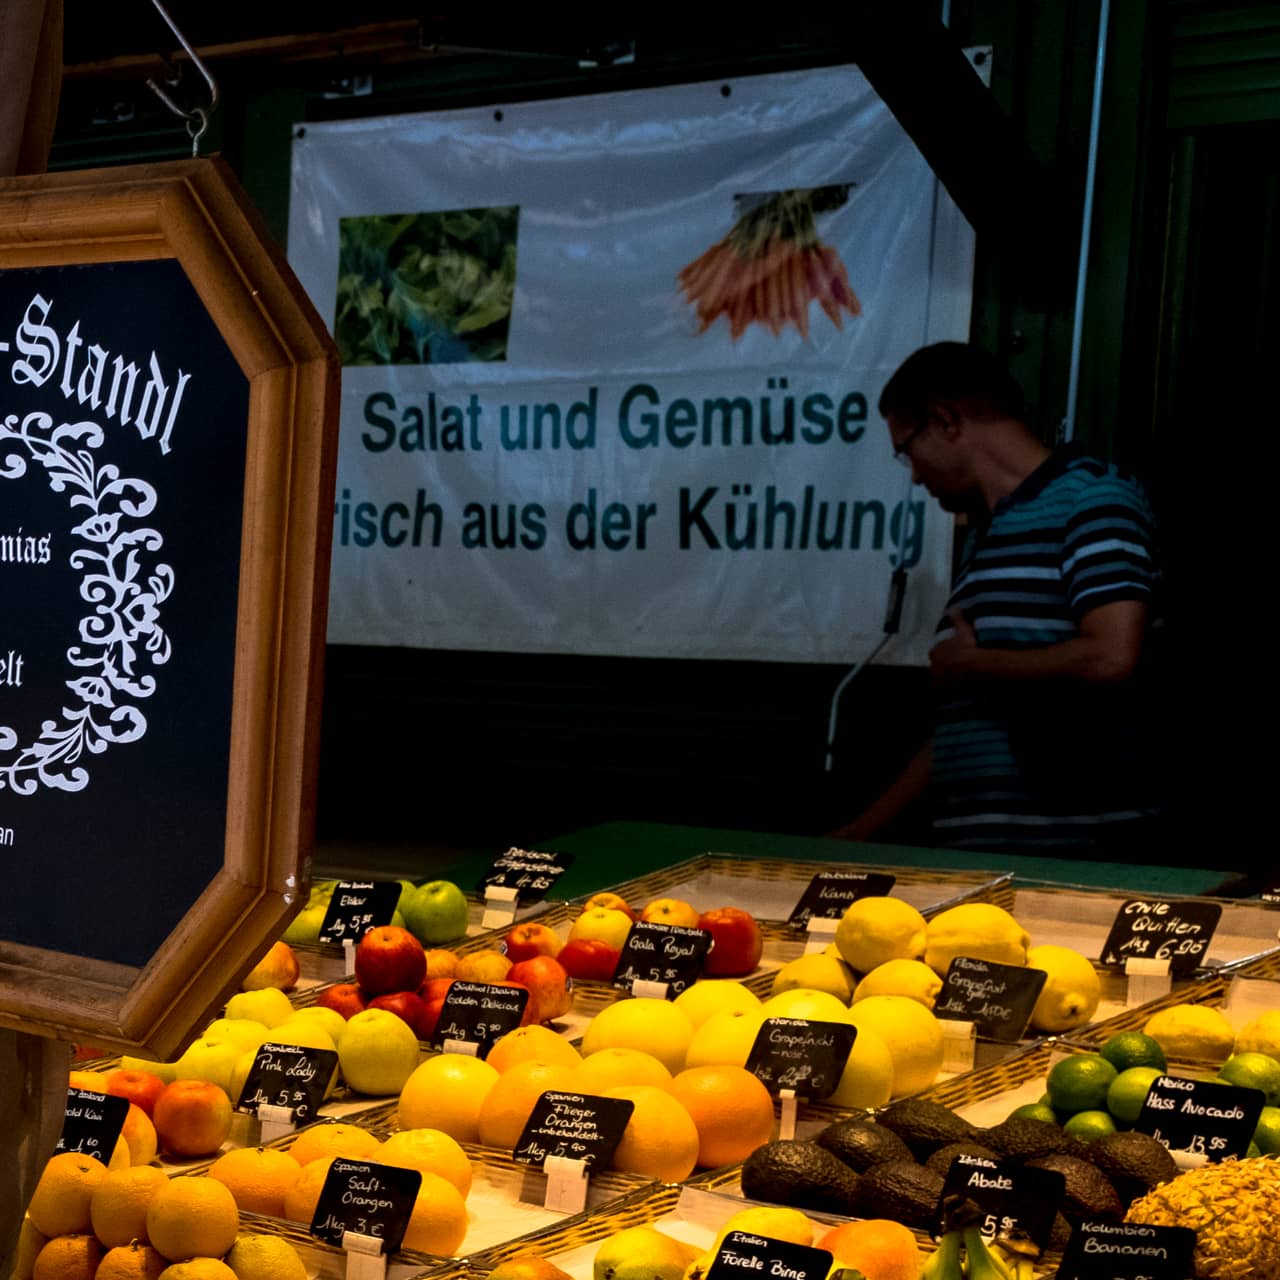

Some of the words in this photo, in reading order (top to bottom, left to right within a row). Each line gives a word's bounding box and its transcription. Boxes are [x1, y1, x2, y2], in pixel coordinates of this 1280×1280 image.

[361, 393, 484, 453] Salat
[499, 389, 597, 449] und
[618, 378, 869, 448] Gemüse
[461, 497, 547, 549] aus
[566, 490, 657, 549] der
[679, 487, 925, 568] Kühlung
[257, 1053, 282, 1071] Pink
[286, 1057, 316, 1082] Lady
[1157, 1077, 1195, 1092] Mexico
[1146, 1091, 1175, 1110] Hass
[1181, 1099, 1244, 1121] Avocado
[544, 1114, 596, 1131] Orangen
[967, 1172, 1012, 1191] Abate
[341, 1192, 391, 1213] Orangen
[1080, 1222, 1155, 1238] Kolumbien
[1083, 1238, 1167, 1260] Bananen
[721, 1250, 764, 1271] Forelle
